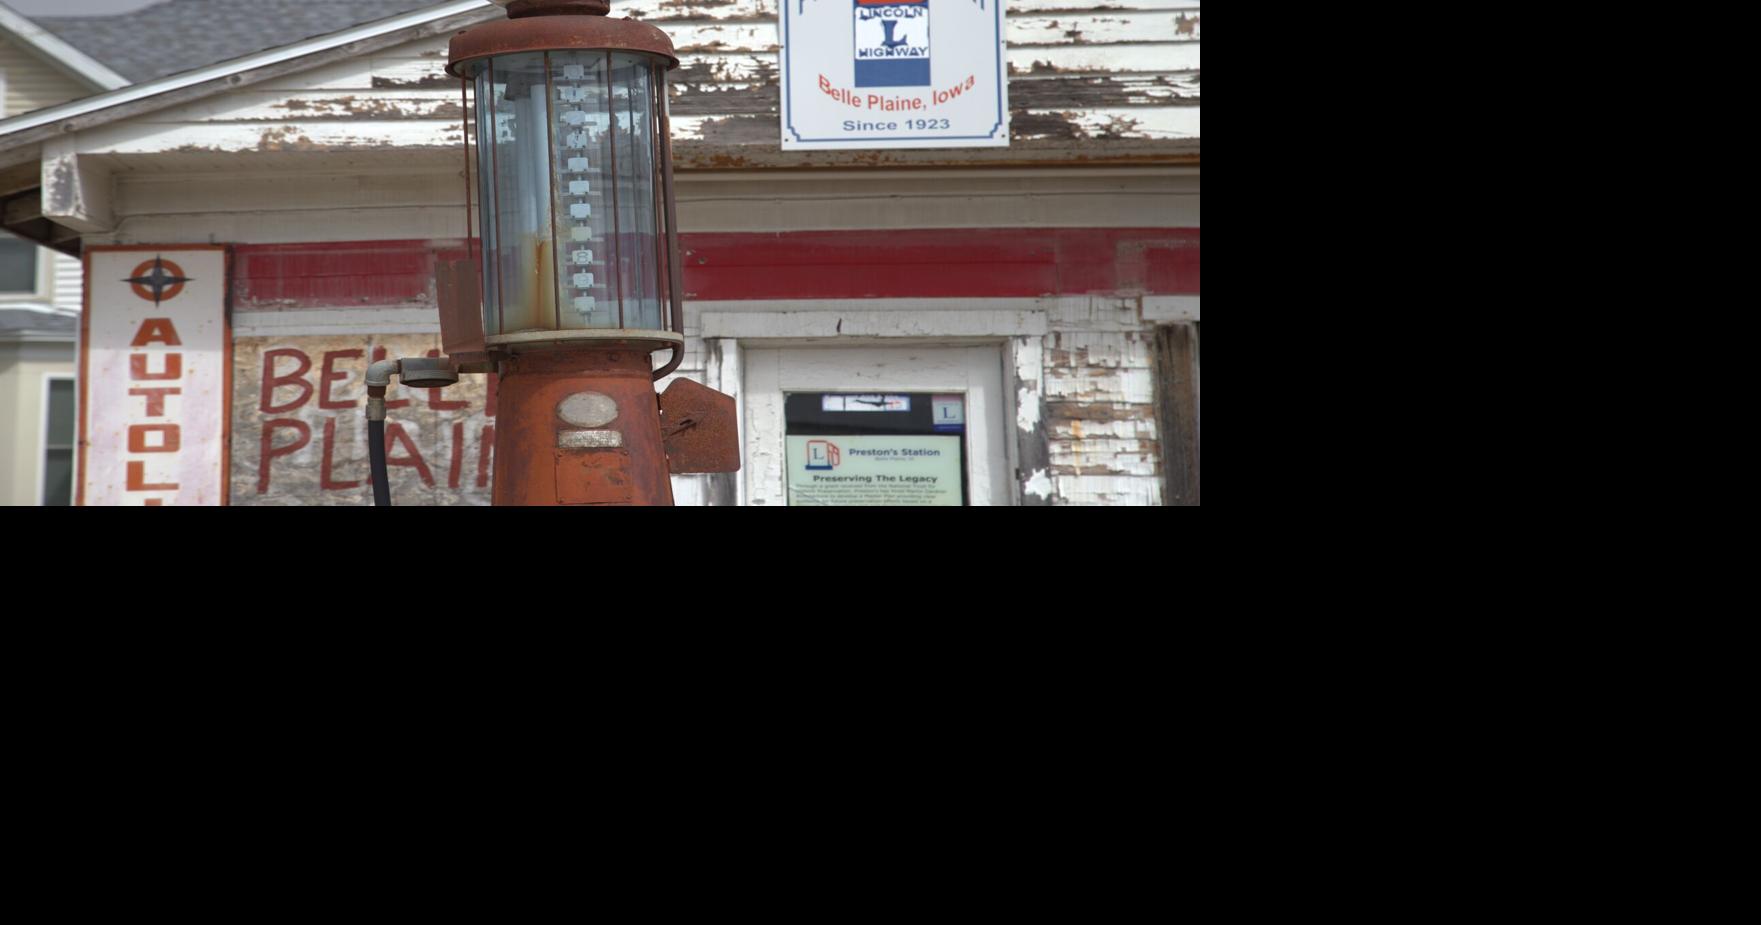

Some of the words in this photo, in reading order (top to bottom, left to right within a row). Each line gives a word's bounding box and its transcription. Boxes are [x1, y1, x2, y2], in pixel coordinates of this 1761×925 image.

[859, 7, 923, 20] LINCOLN
[881, 20, 908, 47] L
[859, 46, 928, 57] HIGHWAY
[818, 74, 861, 108] Belle
[867, 94, 927, 111] Plaine,
[933, 75, 975, 105] Iowa
[843, 119, 897, 132] Since
[905, 118, 950, 131] 1923
[259, 345, 497, 416] BEL
[848, 448, 898, 456] Preston's
[901, 448, 941, 456] Station
[813, 475, 873, 484] Preserving
[876, 475, 897, 483] The
[899, 475, 938, 484] Legacy
